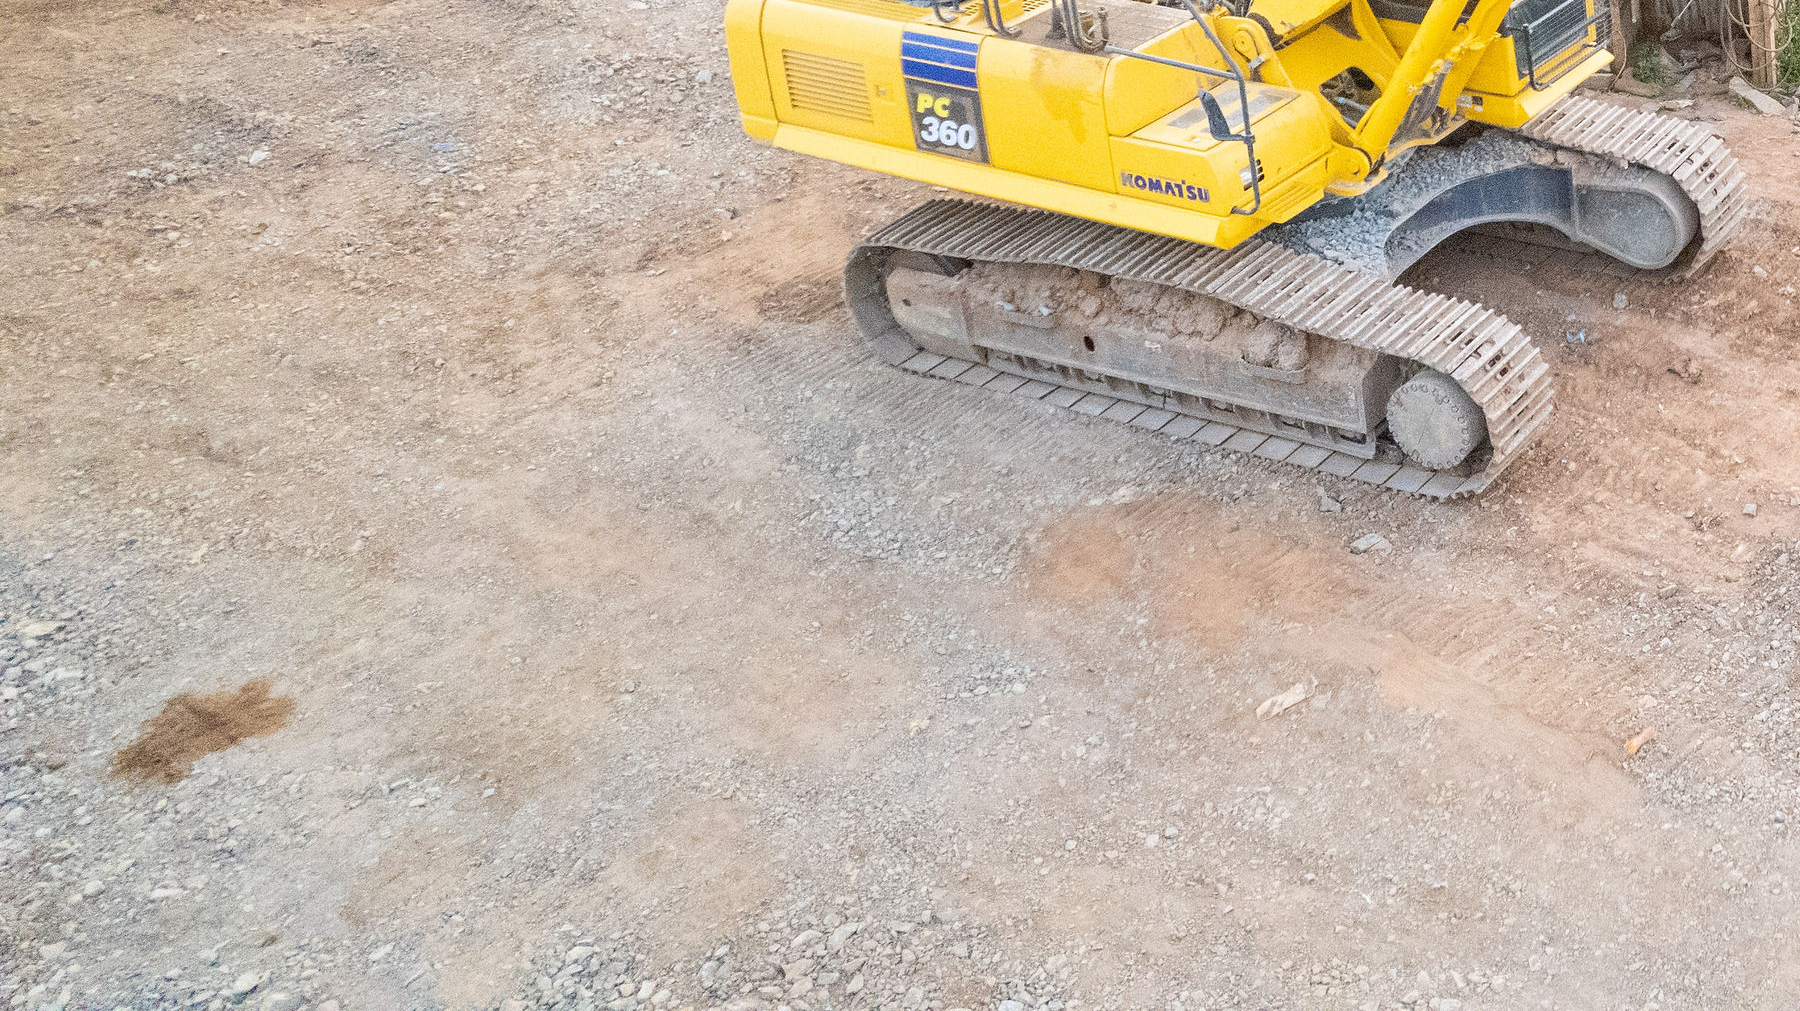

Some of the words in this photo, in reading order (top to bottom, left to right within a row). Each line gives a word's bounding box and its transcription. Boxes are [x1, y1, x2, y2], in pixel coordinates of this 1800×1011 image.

[917, 93, 950, 117] PC
[921, 116, 976, 149] 360
[1121, 171, 1210, 203] KOMATSU
